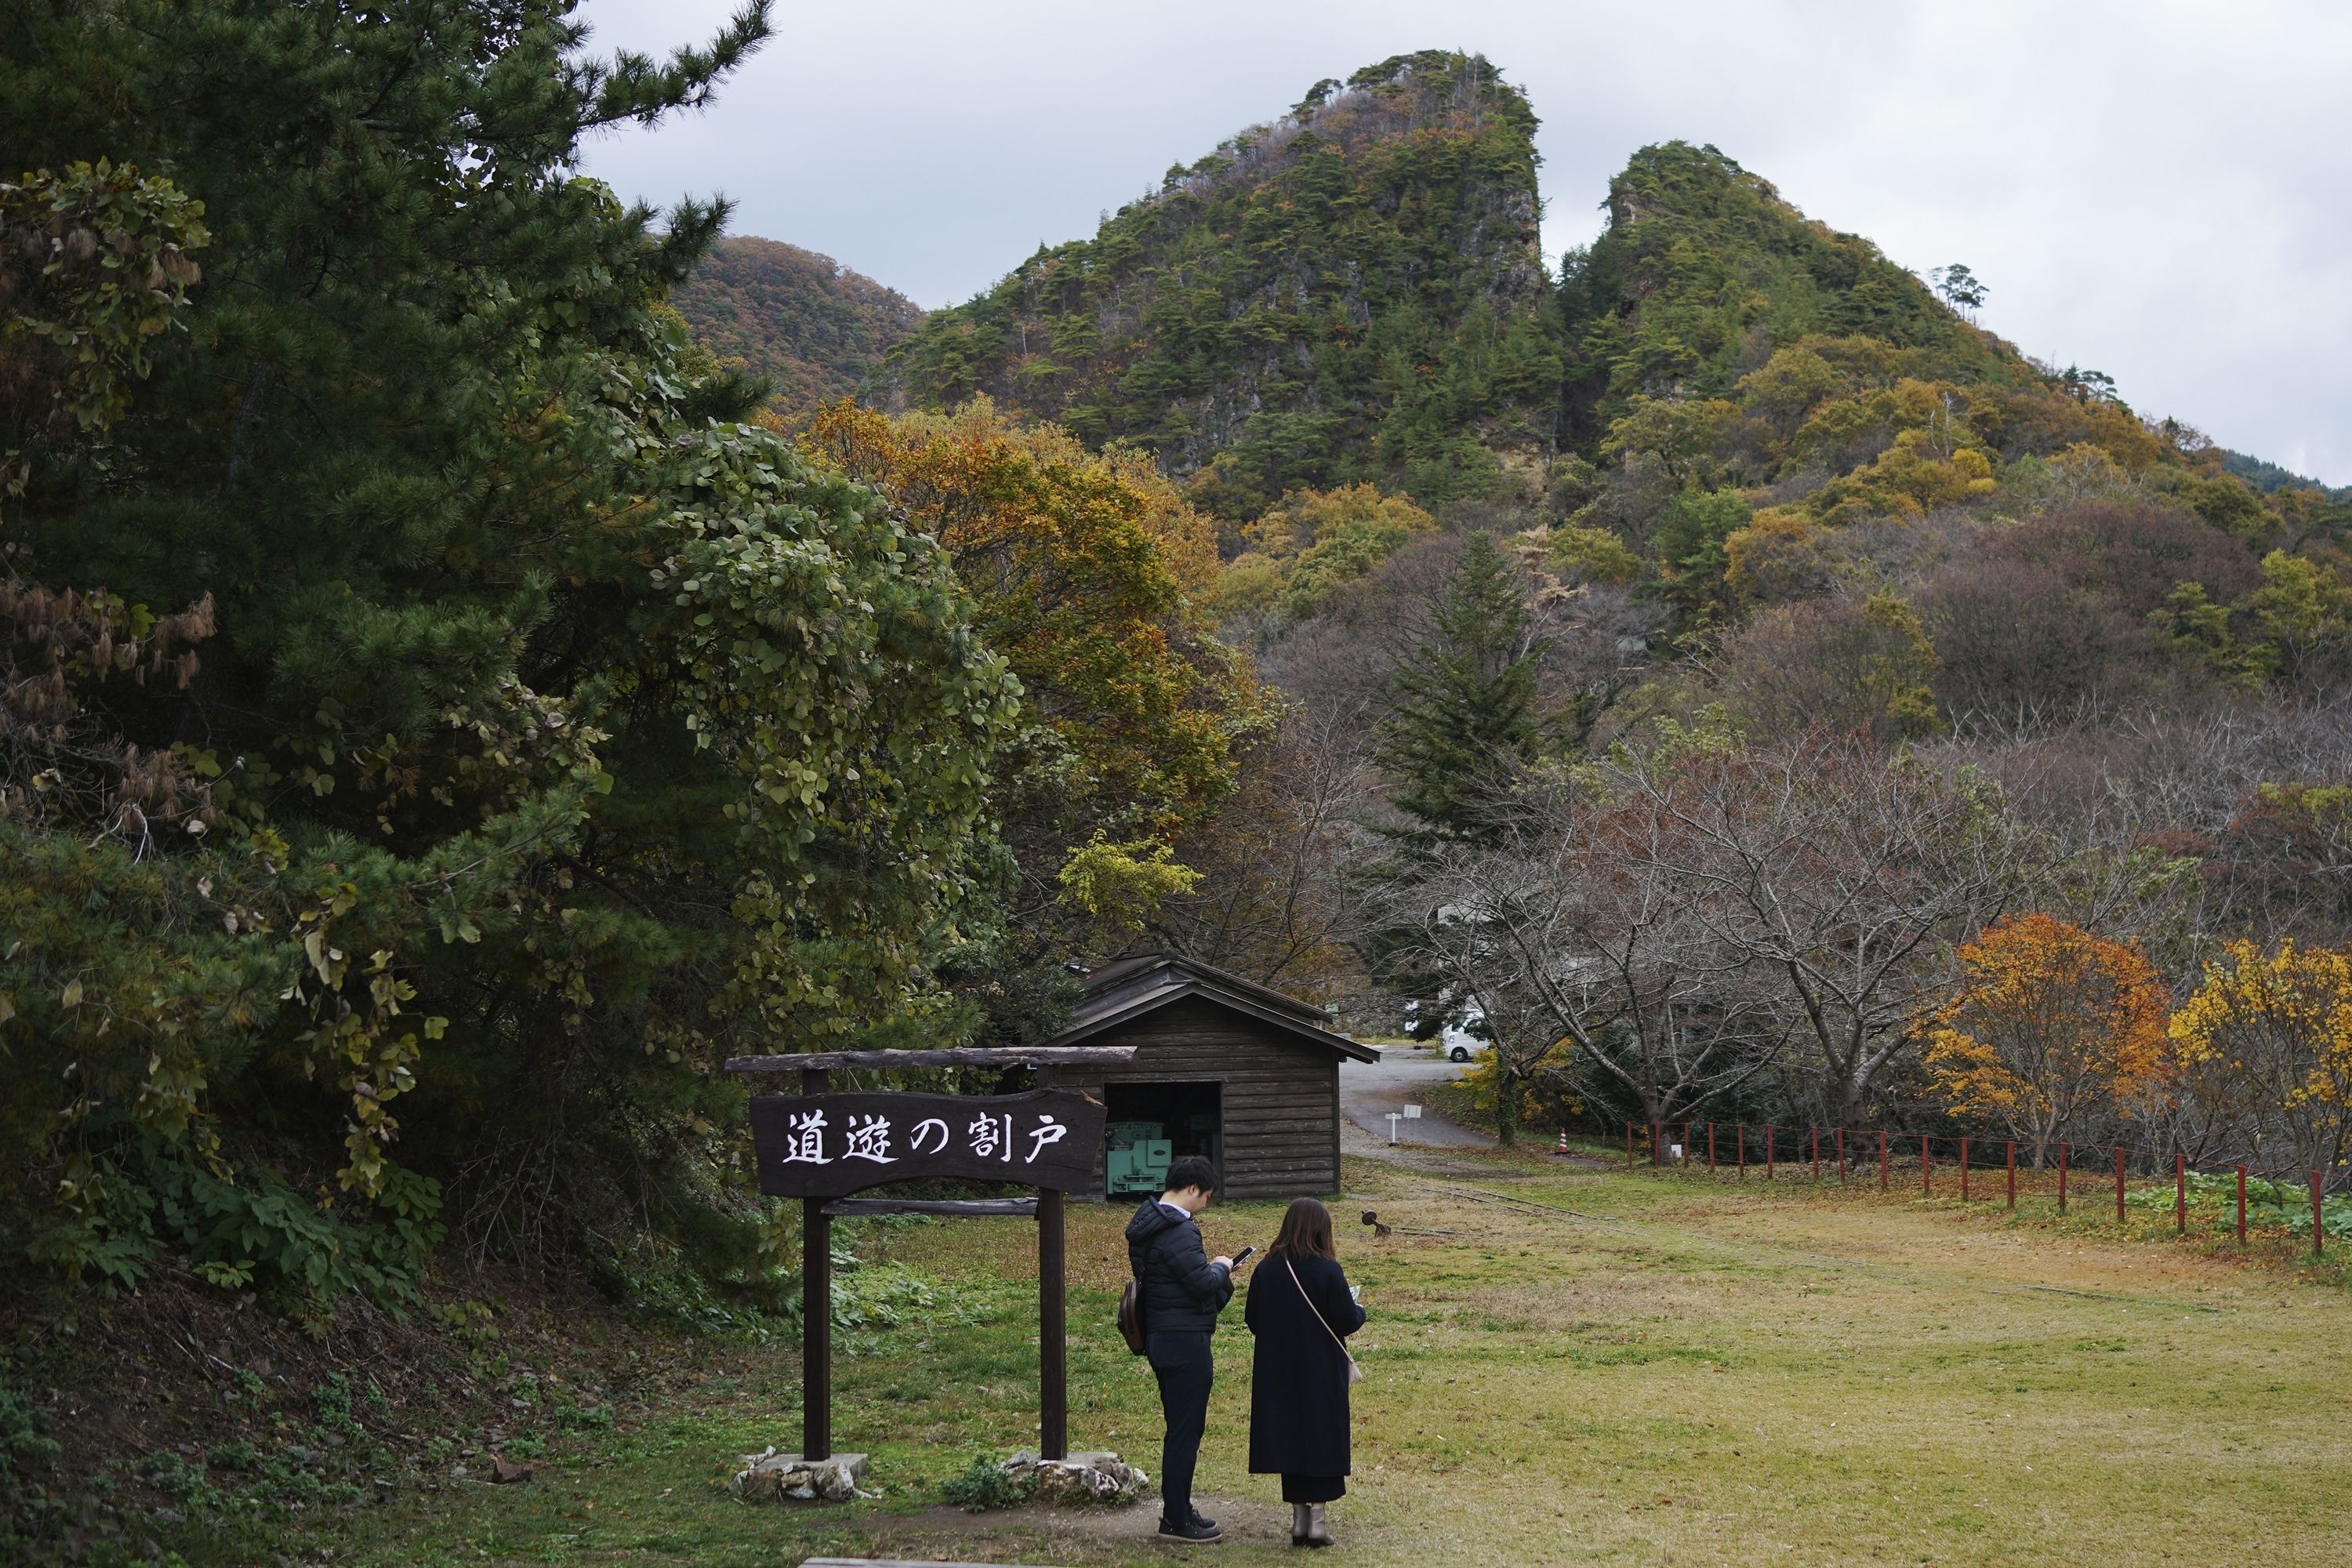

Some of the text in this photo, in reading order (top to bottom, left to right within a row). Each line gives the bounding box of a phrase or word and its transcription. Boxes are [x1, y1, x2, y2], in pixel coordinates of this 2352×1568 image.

[782, 1109, 1067, 1164] 道遊の割戸
